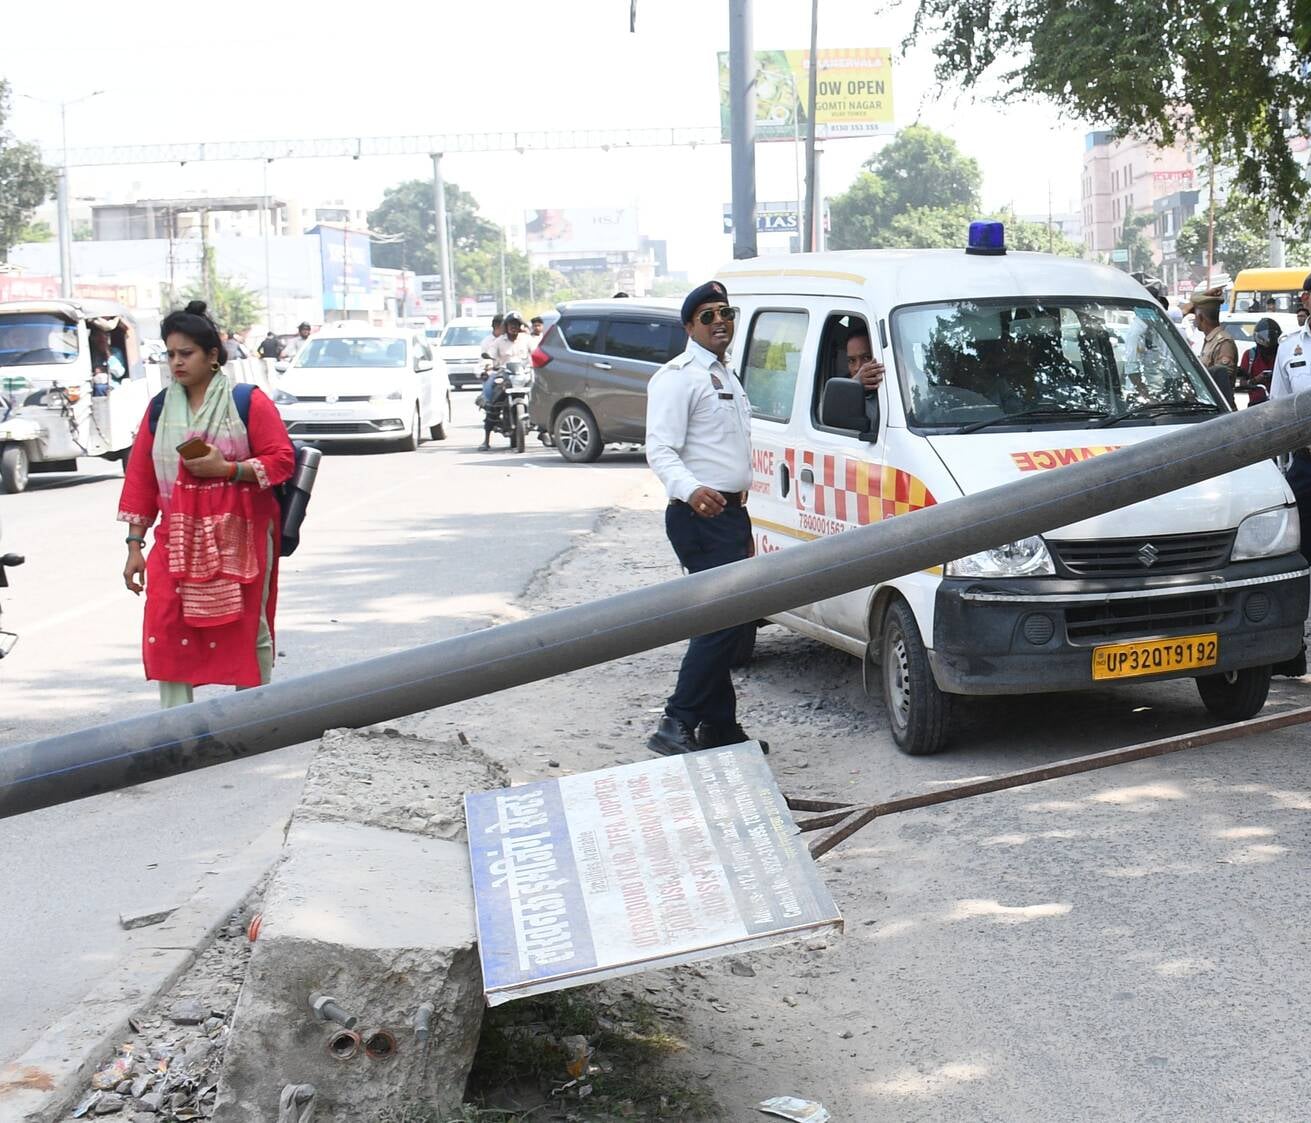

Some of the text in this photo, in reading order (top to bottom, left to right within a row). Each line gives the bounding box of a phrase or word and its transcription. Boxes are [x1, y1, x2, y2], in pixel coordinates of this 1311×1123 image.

[816, 80, 884, 96] OW OPEN
[849, 100, 882, 110] NAGAR
[765, 215, 797, 228] IAS
[753, 448, 774, 476] ANCE
[1107, 641, 1216, 672] UP32QT9192
[575, 830, 599, 862] Available
[486, 828, 569, 903] इमेजिंग
[510, 890, 576, 970] लखनऊ
[618, 880, 660, 949] ULTRASOUND
